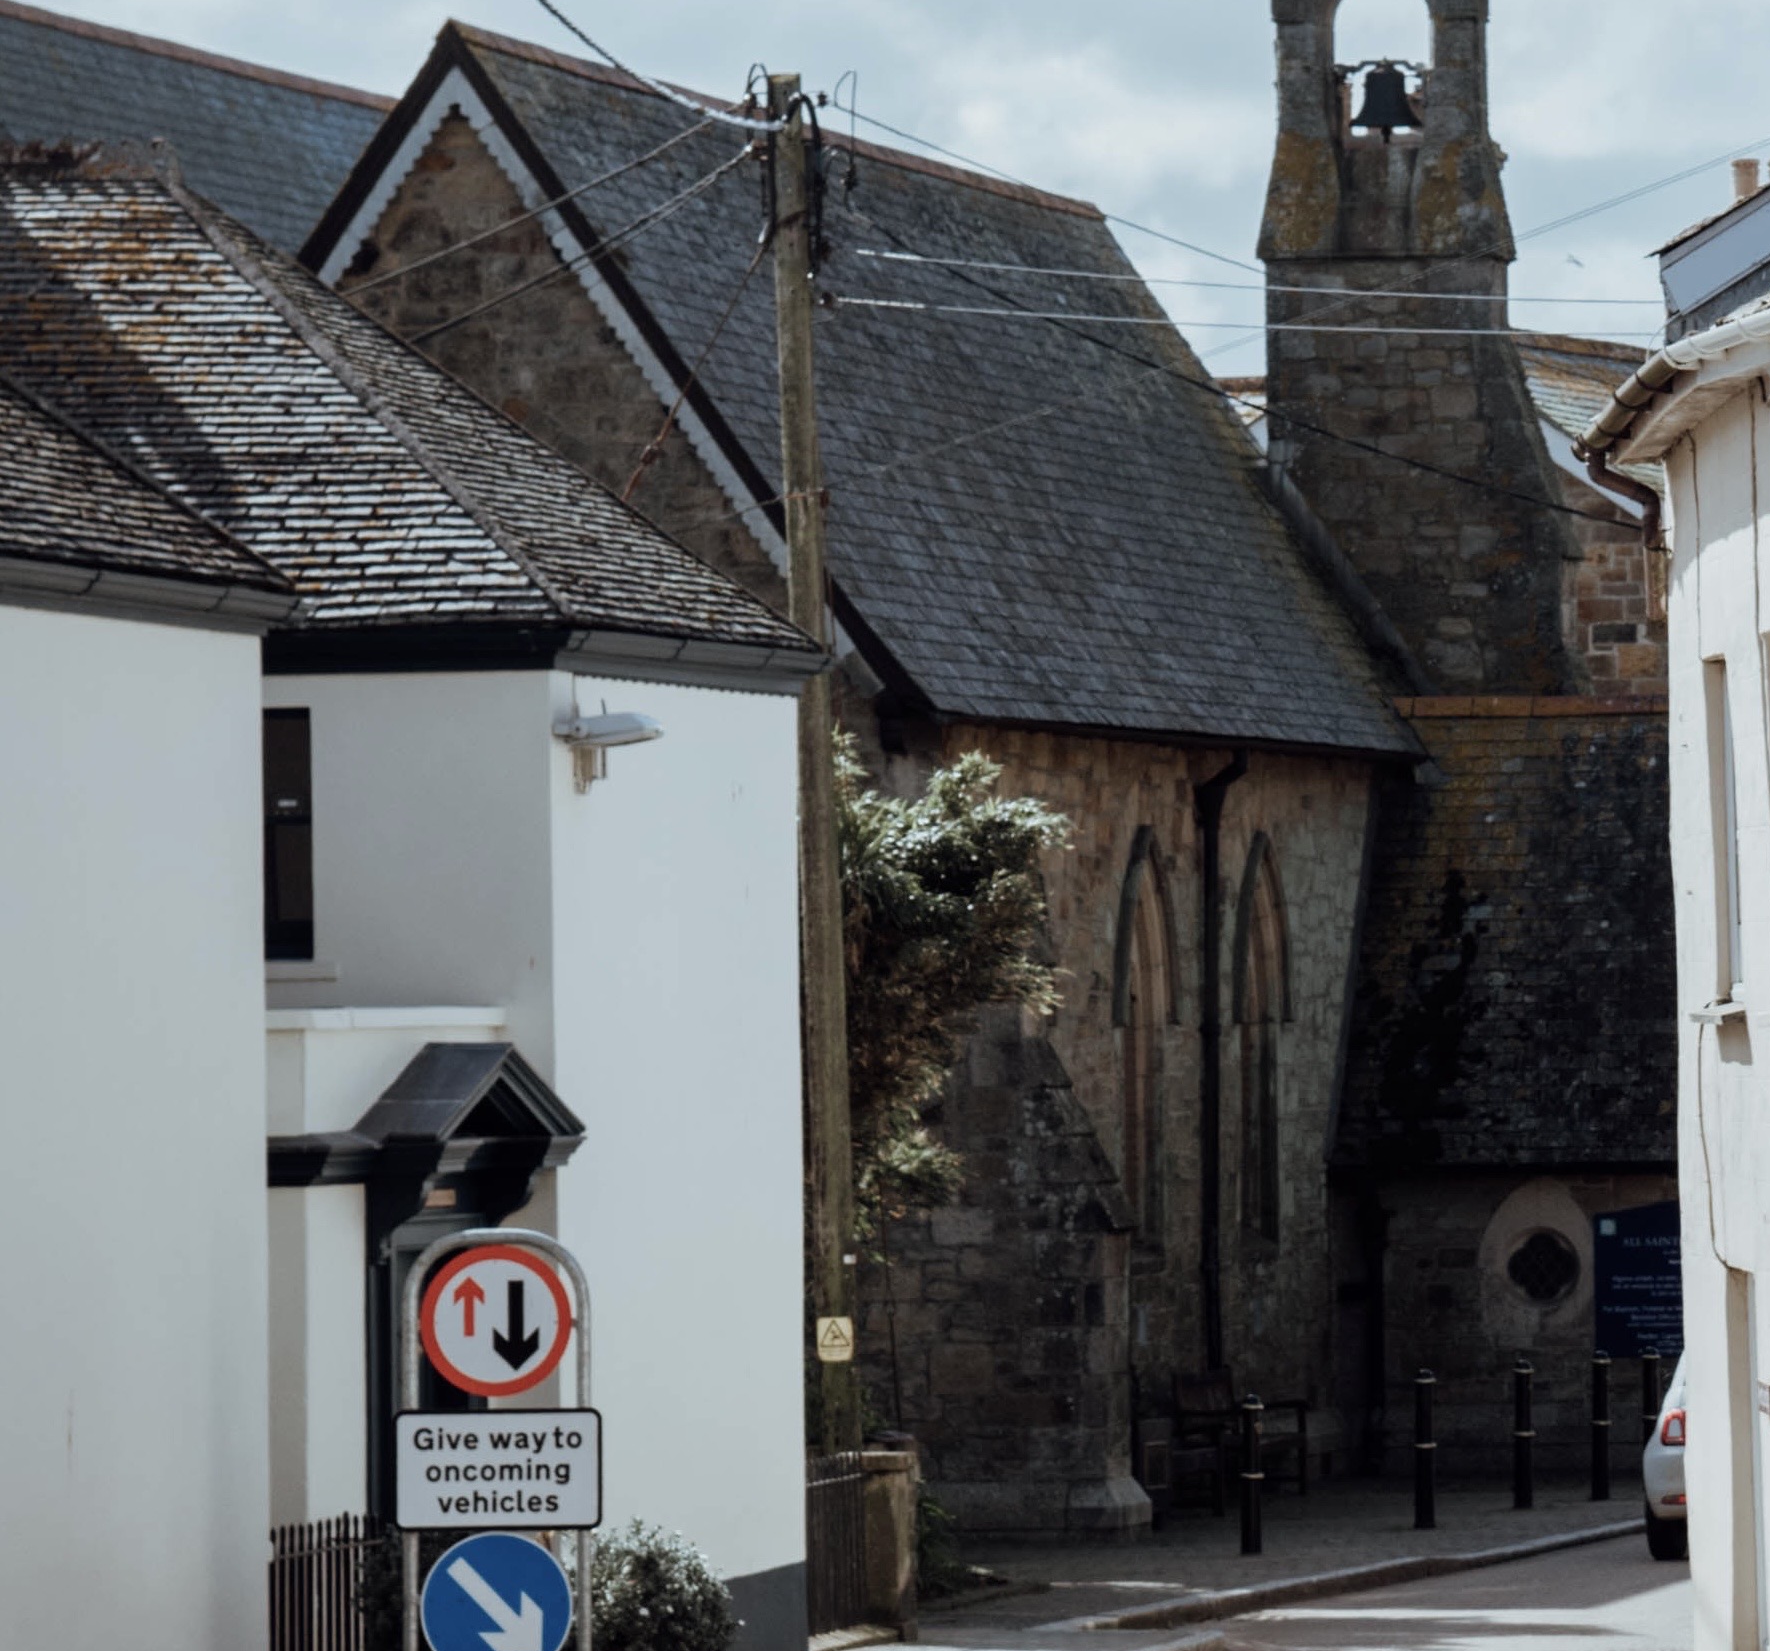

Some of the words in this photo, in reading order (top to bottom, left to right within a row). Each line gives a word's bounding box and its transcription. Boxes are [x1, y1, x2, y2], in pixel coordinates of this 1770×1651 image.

[1645, 1236, 1679, 1246] SAINT
[413, 1427, 479, 1451] Give
[489, 1432, 547, 1455] way
[552, 1426, 583, 1450] to
[425, 1458, 571, 1486] oncoming
[437, 1489, 559, 1514] vehicles
